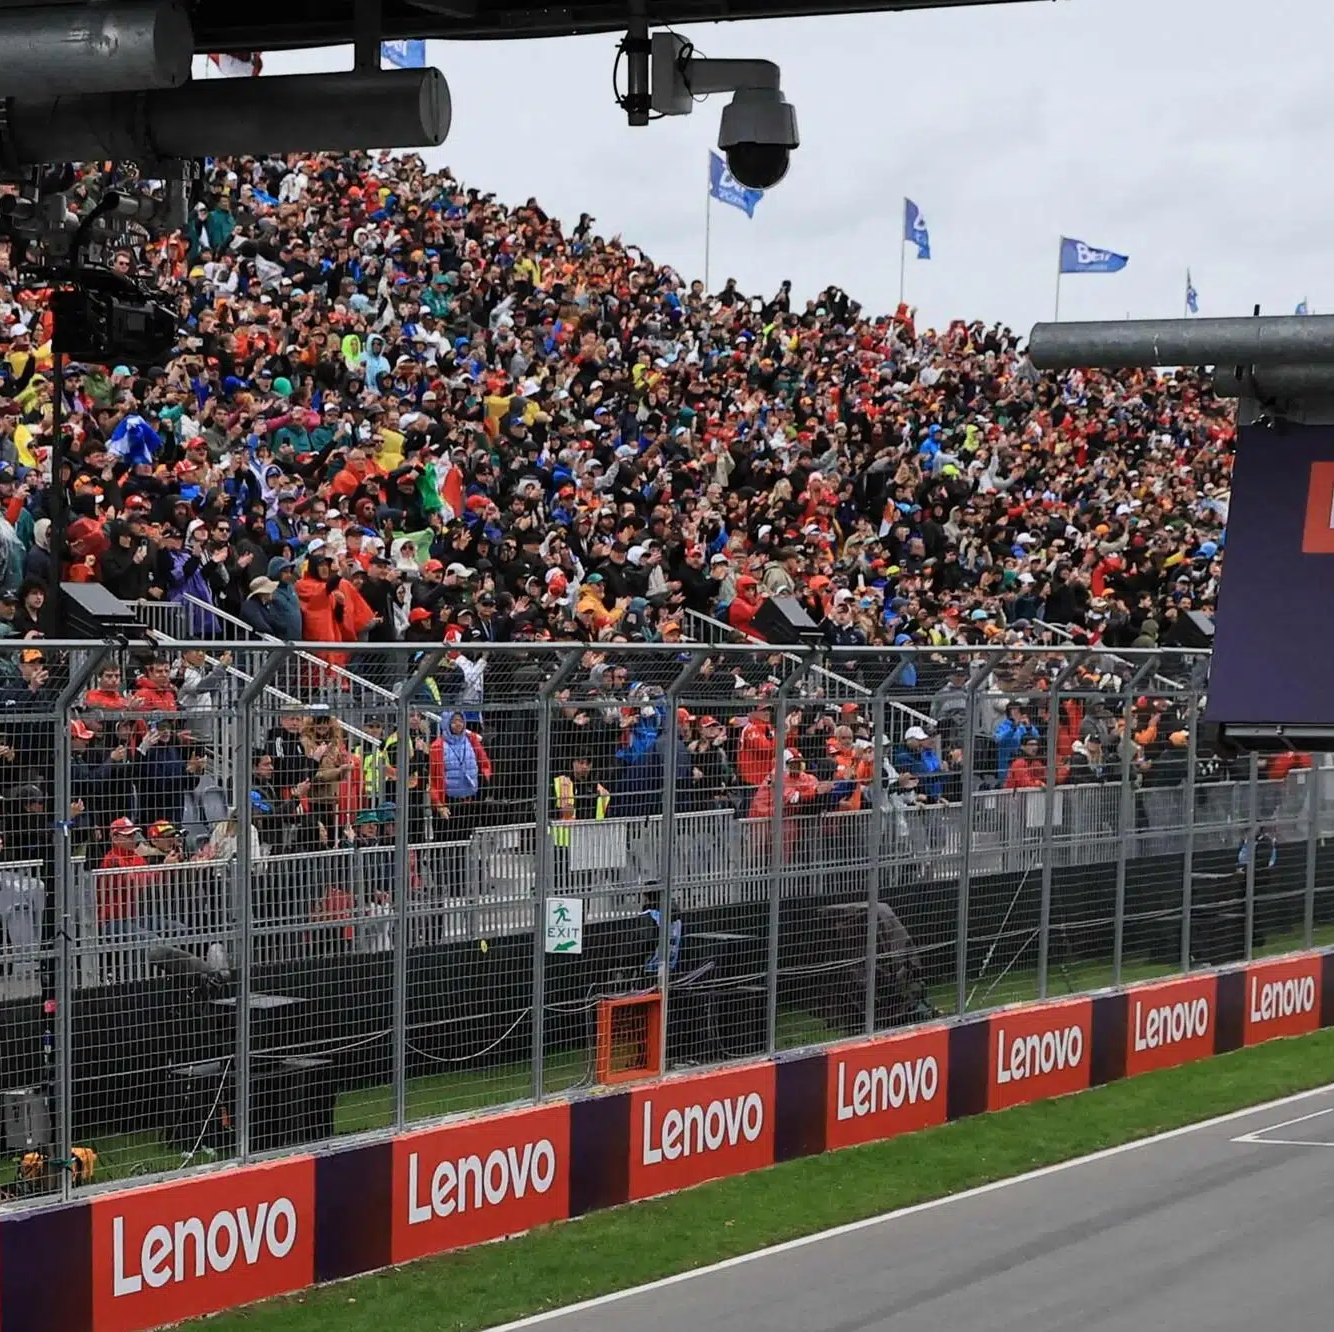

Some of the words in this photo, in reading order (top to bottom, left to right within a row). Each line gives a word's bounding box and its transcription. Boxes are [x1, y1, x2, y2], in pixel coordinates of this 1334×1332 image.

[547, 927, 580, 938] EXIT
[1134, 997, 1208, 1052] Lenovo
[1250, 976, 1315, 1023] Lenovo
[998, 1024, 1083, 1084] Lenovo
[837, 1056, 938, 1121] Lenovo
[643, 1092, 763, 1165] Lenovo
[408, 1140, 556, 1225] Lenovo
[113, 1198, 297, 1297] Lenovo
